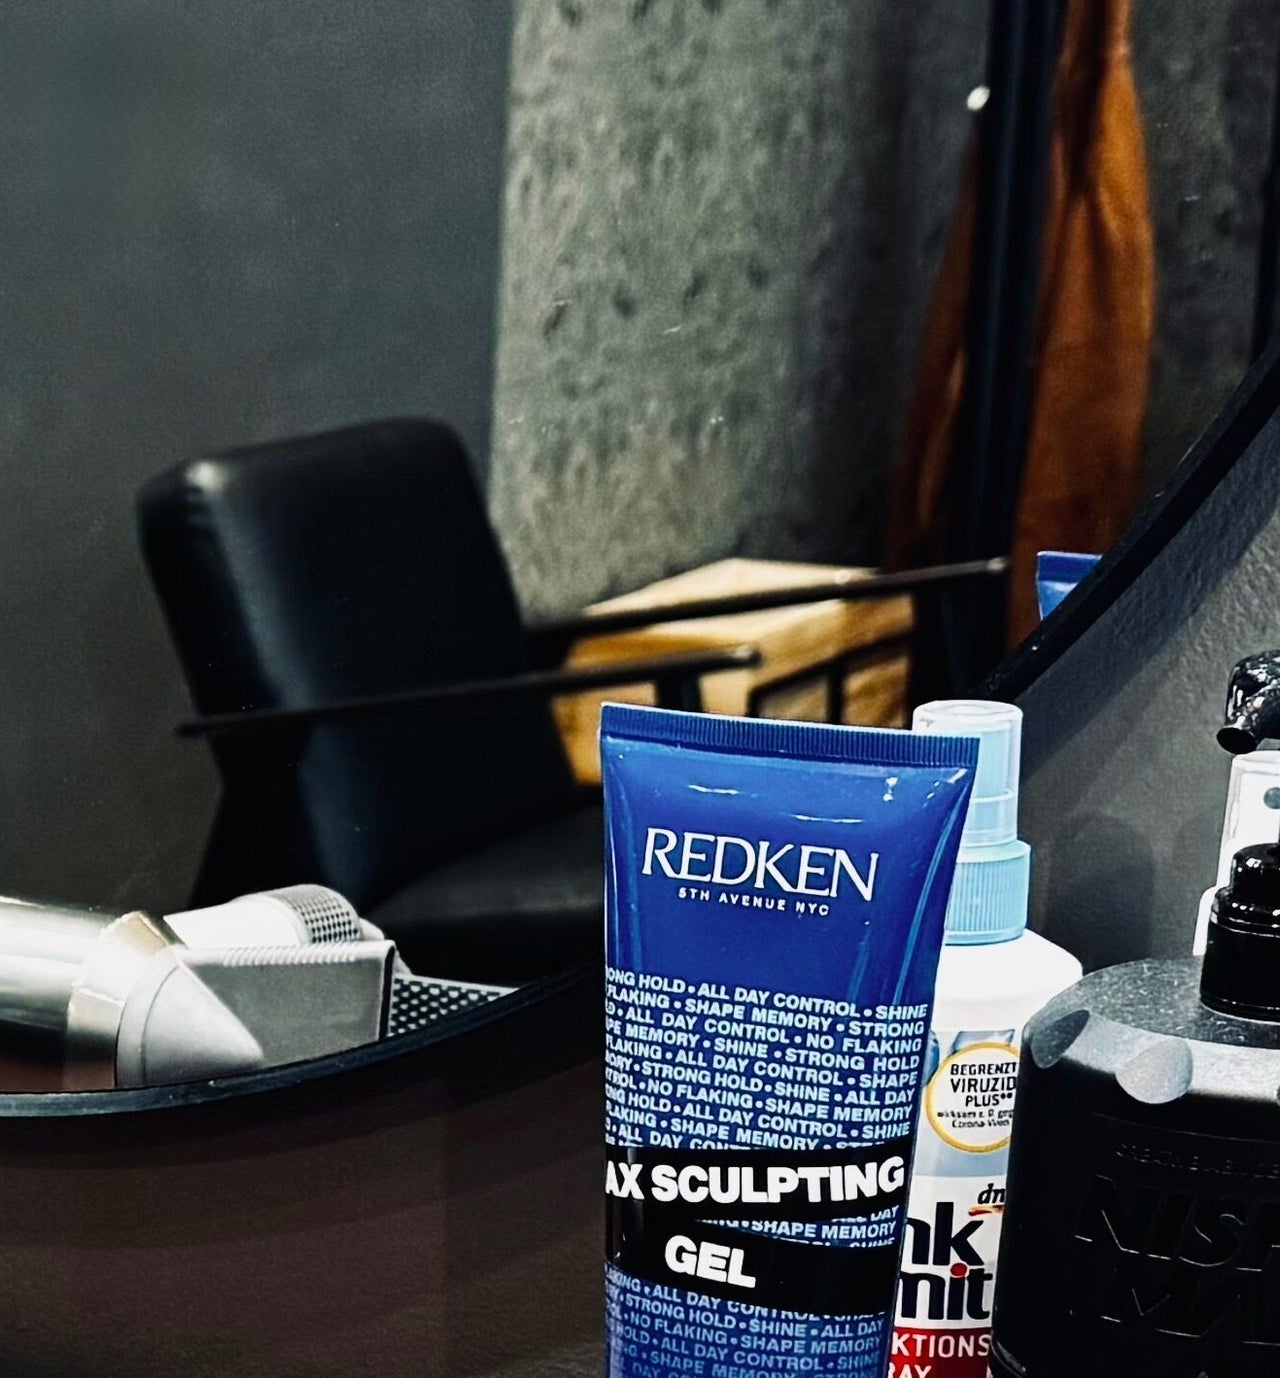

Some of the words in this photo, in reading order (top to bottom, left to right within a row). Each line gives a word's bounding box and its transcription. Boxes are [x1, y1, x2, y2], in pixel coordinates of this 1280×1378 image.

[641, 827, 880, 902] REDKEN
[677, 885, 711, 902] 5TH
[719, 892, 786, 912] AVENUE
[795, 901, 830, 917] NYC
[639, 974, 687, 994] HOLD
[697, 982, 731, 1000] ALL
[734, 987, 771, 1005] DAY
[773, 992, 861, 1018] CONTROL
[875, 1003, 929, 1021] SHINE
[684, 998, 746, 1021] SHAPE
[751, 1007, 833, 1032] MEMORY
[848, 1020, 925, 1037] STRONG
[625, 1006, 655, 1024] ALL
[661, 1012, 698, 1030] DAY
[704, 1018, 790, 1044] CONTROL
[806, 1032, 835, 1049] NO
[842, 1037, 923, 1055] FLAKING
[625, 1022, 701, 1048] MEMORY
[713, 1037, 769, 1058] SHINE
[784, 1047, 865, 1071] STRONG
[873, 1055, 920, 1072] HOLD
[641, 1060, 712, 1085] STRONG
[714, 1072, 764, 1093] HOLD
[773, 1081, 831, 1102] SHINE
[844, 1090, 881, 1106] ALL
[884, 1088, 916, 1106] DAY
[675, 1049, 708, 1067] ALL
[712, 1055, 750, 1073] DAY
[753, 1061, 844, 1086] CONTROL
[859, 1071, 919, 1089] SHAPE
[950, 1076, 1017, 1093] VIRUZID
[628, 1092, 672, 1112] HOLD
[682, 1103, 714, 1120] ALL
[718, 1108, 755, 1126] DAY
[757, 1114, 848, 1138] CONTROL
[861, 1122, 911, 1139] SHINE
[647, 1078, 672, 1096] NO
[676, 1085, 753, 1109] FLAKING
[765, 1098, 829, 1119] SHAPE
[833, 1105, 913, 1122] MEMORY
[618, 1124, 643, 1142] ALL
[649, 1130, 684, 1149] DAY
[670, 1117, 730, 1140] SHAPE
[735, 1127, 820, 1151] MEMORY
[651, 1156, 905, 1204] SCULPTING
[821, 1221, 896, 1240] MEMORY
[664, 1235, 756, 1288] GEL
[625, 1293, 685, 1320] STRONG
[689, 1308, 737, 1329] HOLD
[749, 1319, 808, 1337] SHINE
[820, 1324, 855, 1338] ALL
[857, 1318, 885, 1336] DAY
[652, 1285, 682, 1302] ALL
[686, 1291, 721, 1310] DAY
[630, 1311, 651, 1328] NO
[654, 1318, 728, 1345] FLAKING
[740, 1335, 806, 1353] SHAPE
[810, 1336, 882, 1354] MEMORY
[661, 1337, 689, 1355] ALL
[694, 1344, 729, 1362] DAY
[734, 1352, 824, 1371] CONTROL
[650, 1351, 706, 1374] SHAPE
